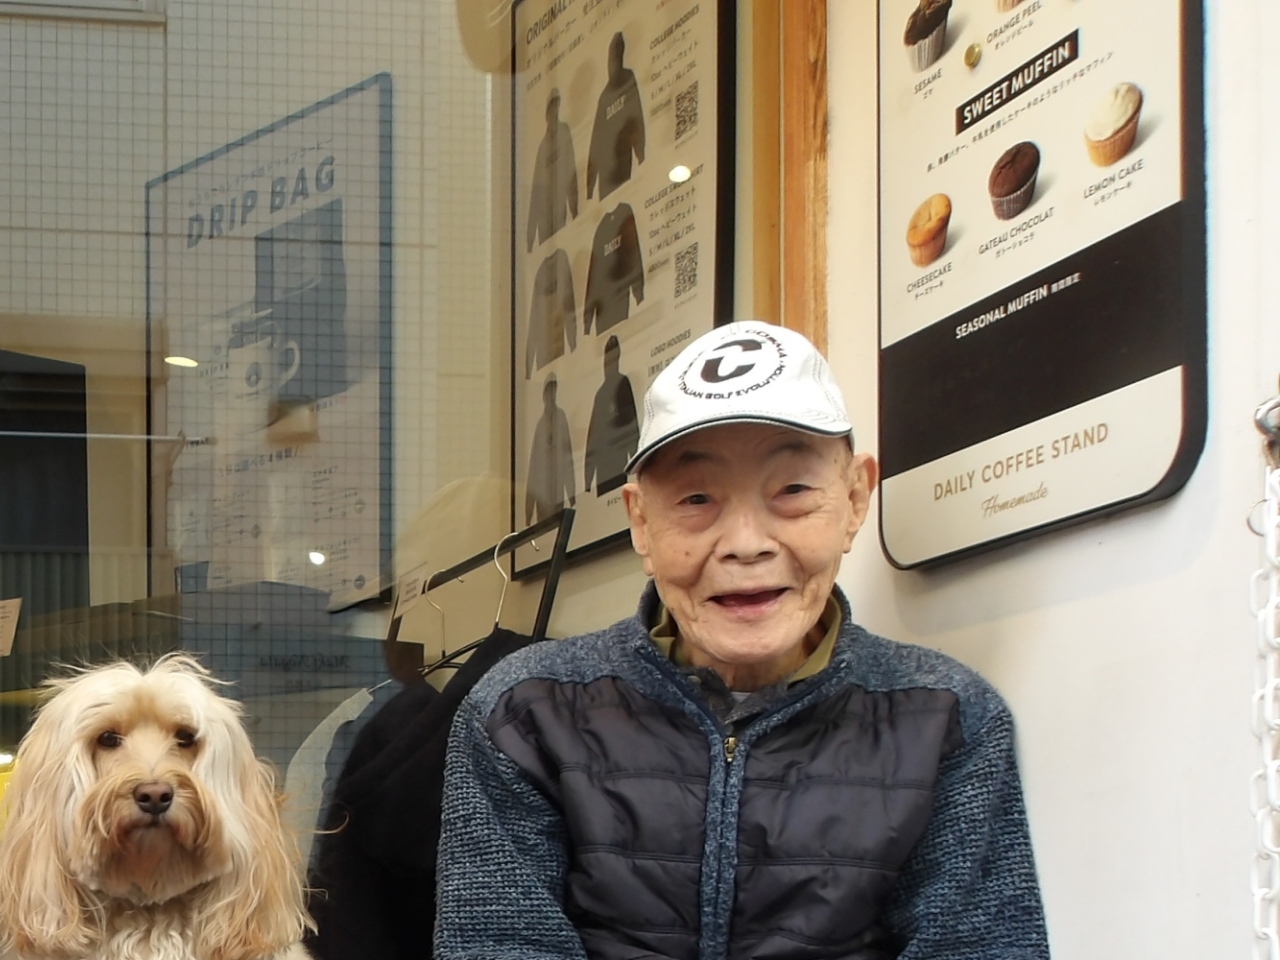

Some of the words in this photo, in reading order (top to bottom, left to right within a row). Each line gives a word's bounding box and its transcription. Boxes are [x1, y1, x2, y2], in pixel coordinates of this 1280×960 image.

[526, 0, 568, 46] ORIGINAL
[649, 24, 674, 51] COLLEGE
[674, 4, 700, 29] HOODIES
[986, 15, 1020, 43] ORANGE
[1022, 0, 1042, 20] PEEL
[914, 68, 942, 94] SESAME
[963, 81, 1010, 124] SWEET
[1010, 41, 1070, 95] MUFFIN
[644, 183, 669, 209] COLLEGE
[1083, 176, 1115, 199] LEMON
[1118, 158, 1144, 180] CAKE
[186, 189, 258, 249] DRIP
[270, 155, 336, 214] BAG
[978, 231, 1008, 255] GATEAU
[1009, 207, 1055, 241] CHOCOLAT
[906, 262, 953, 293] CHEESECAKE
[955, 305, 1007, 339] SEASONAL
[1007, 284, 1049, 314] MUFFIN
[650, 342, 666, 358] LOGO
[666, 328, 692, 348] HOODIES
[705, 392, 733, 400] GOLF
[934, 469, 975, 501] DAILY
[981, 445, 1044, 483] COFFEE
[1051, 422, 1109, 459] STAND
[981, 481, 1048, 519] Homemade
